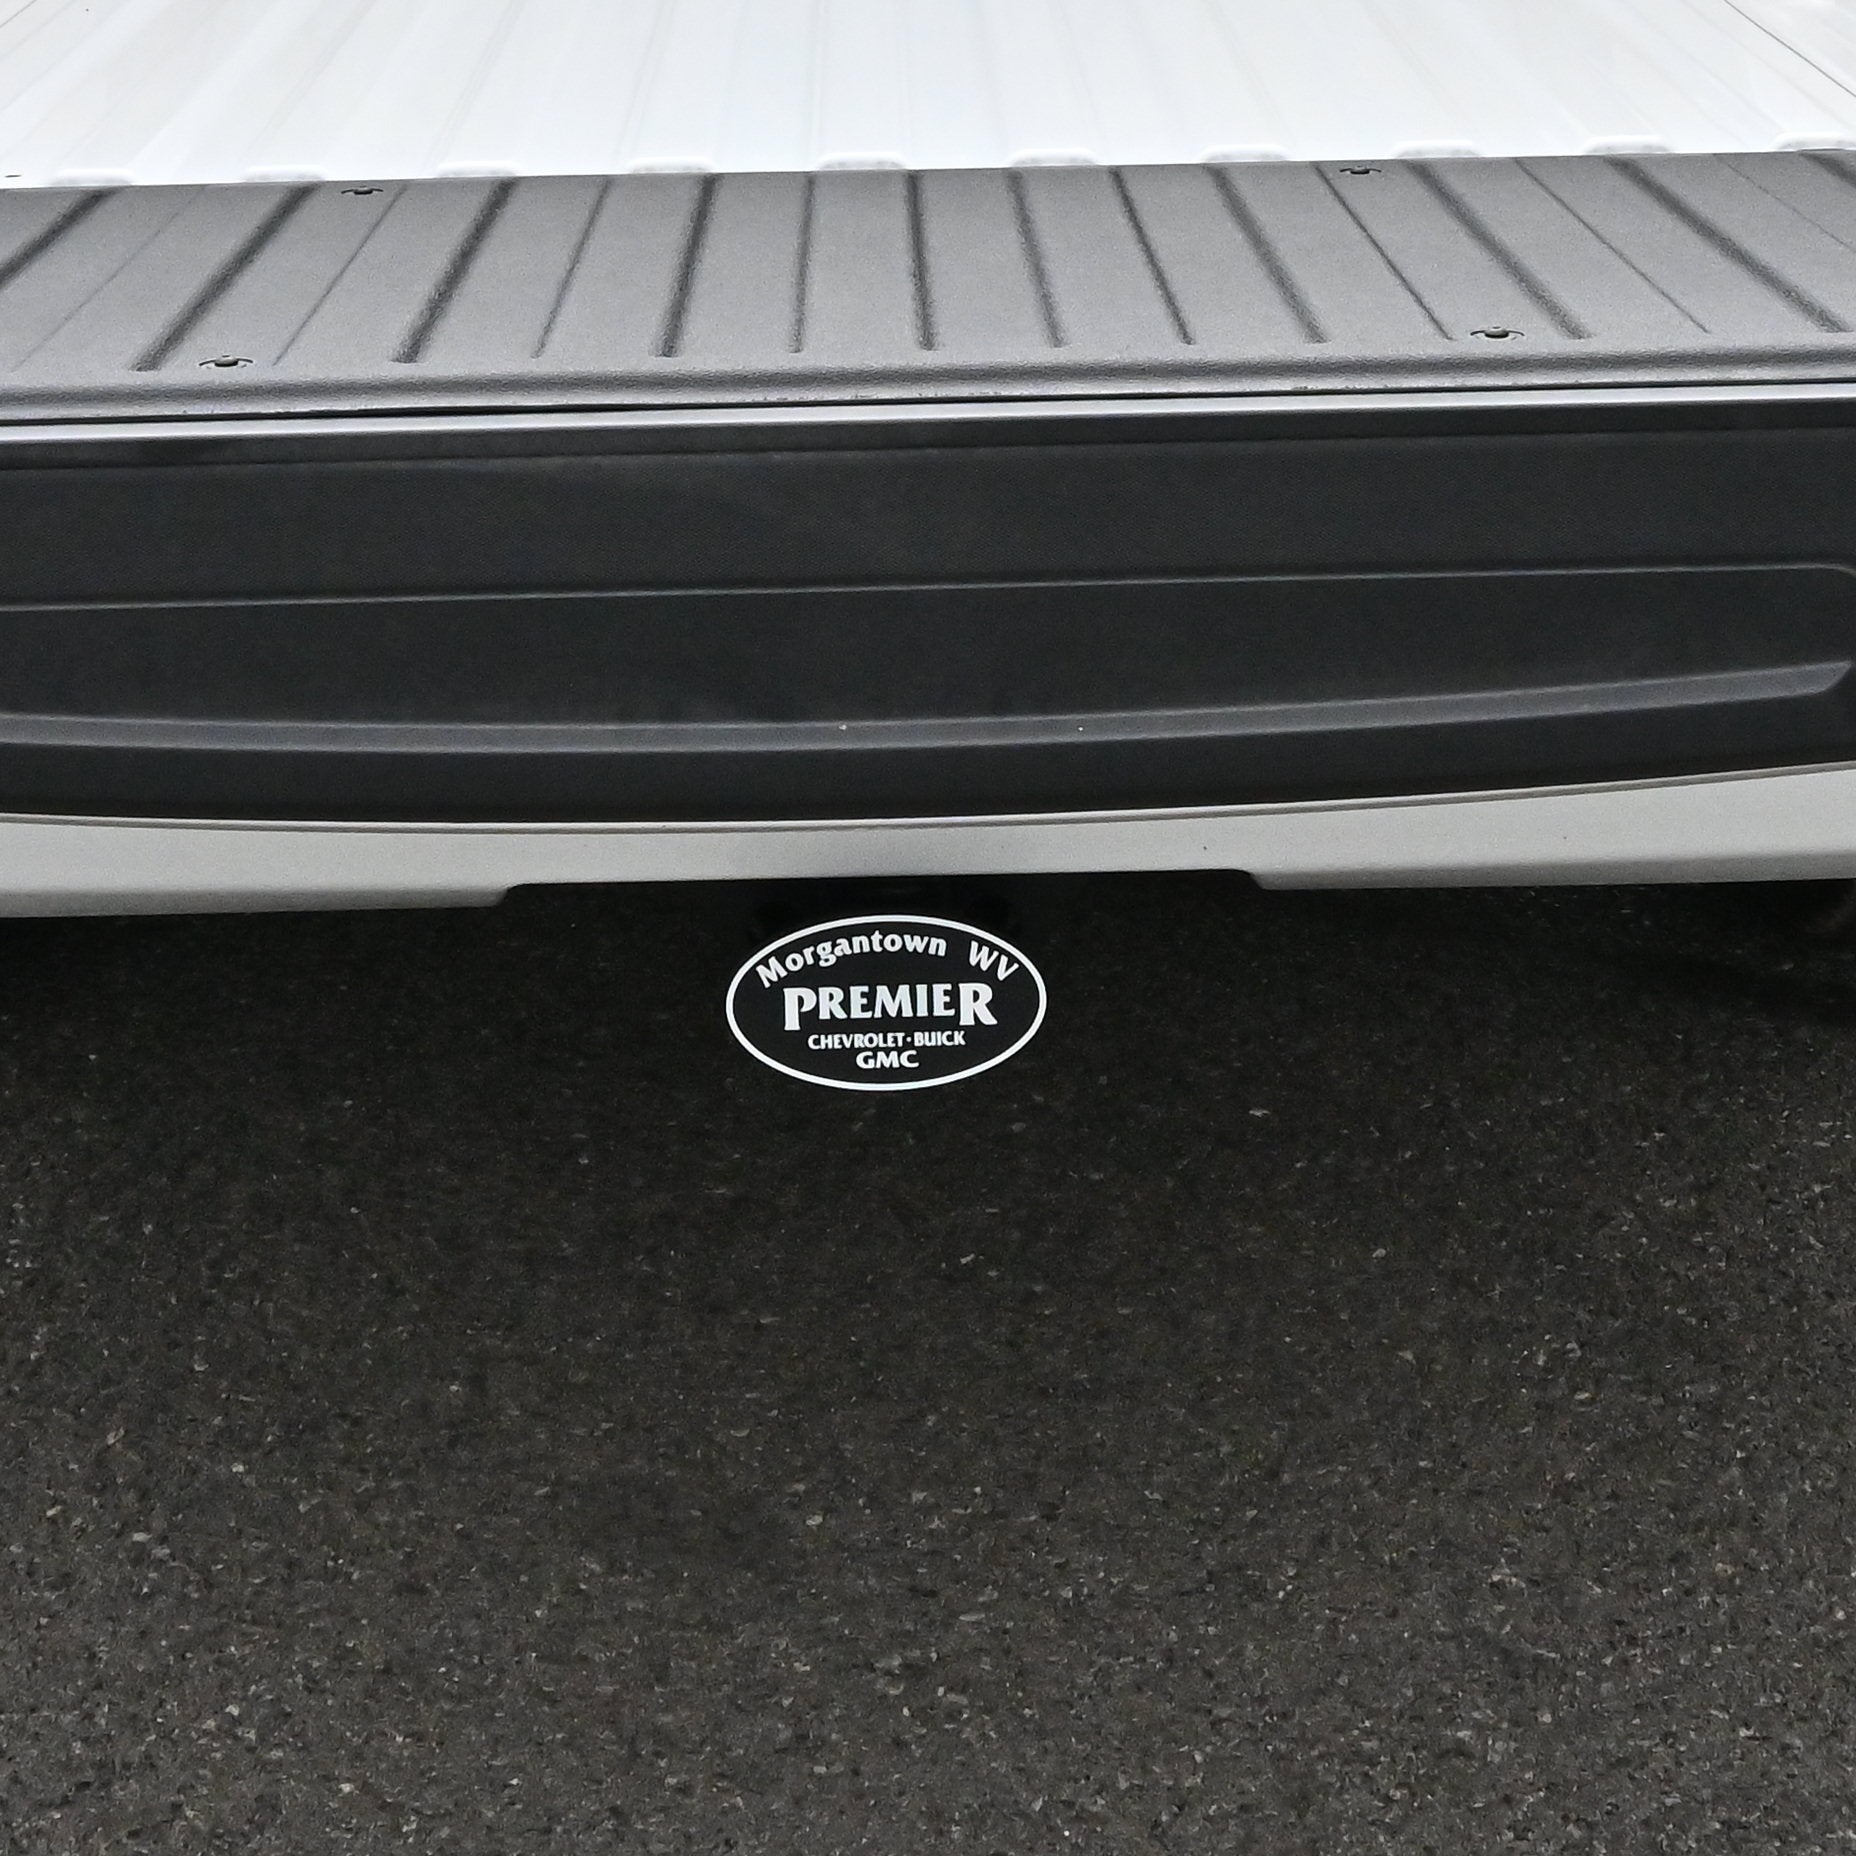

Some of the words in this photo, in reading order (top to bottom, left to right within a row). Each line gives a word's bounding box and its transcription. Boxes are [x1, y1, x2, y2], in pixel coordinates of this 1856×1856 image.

[755, 930, 947, 988] Morgantown
[968, 941, 1019, 981] WV
[783, 982, 998, 1031] PREMIER
[855, 1050, 920, 1069] GMC
